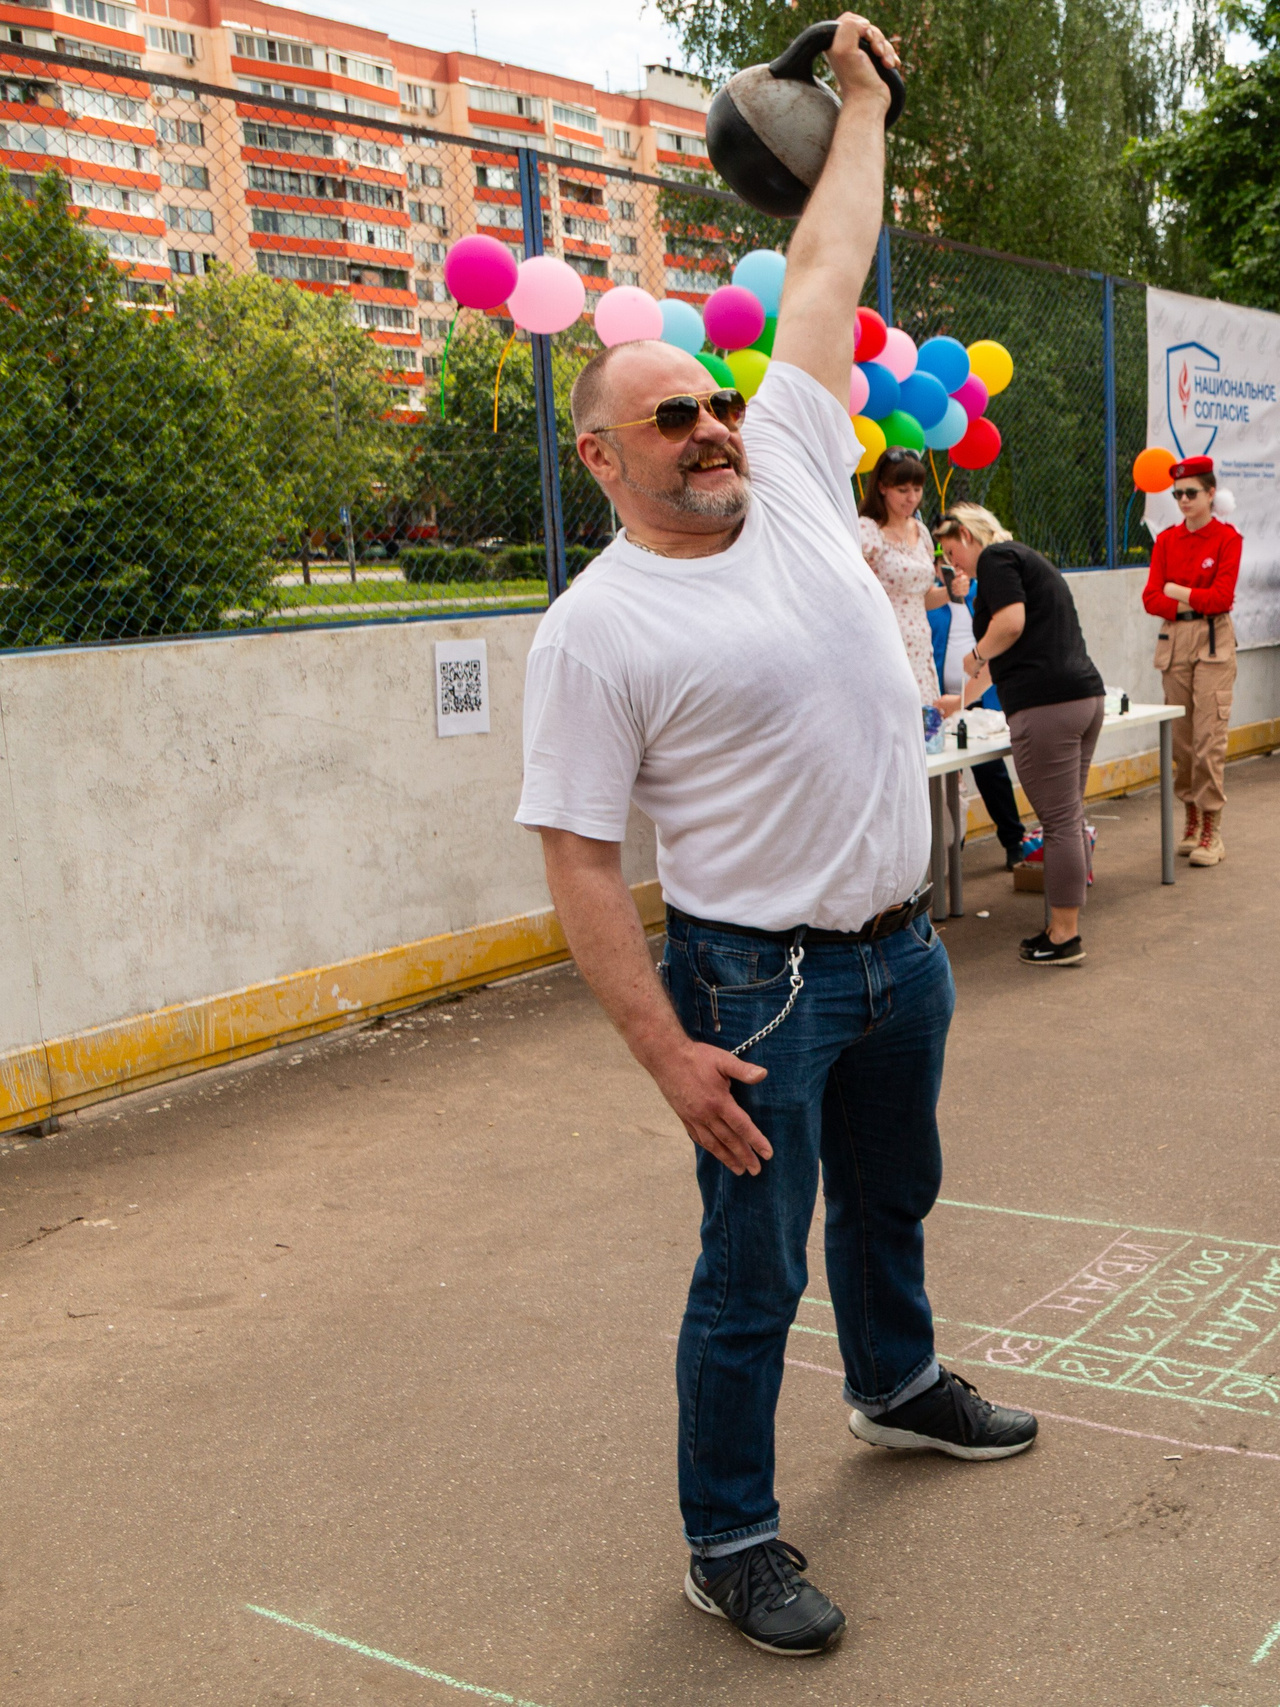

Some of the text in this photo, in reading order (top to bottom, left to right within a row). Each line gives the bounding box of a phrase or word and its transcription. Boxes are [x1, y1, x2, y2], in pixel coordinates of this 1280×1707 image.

[1194, 375, 1277, 402] НАЦИОНАЛЬНОЕ
[1194, 400, 1250, 423] СОГЛАСИЕ
[1038, 1241, 1167, 1313] ИВАН
[1107, 1248, 1243, 1340] ВОЛОДЯ
[984, 1335, 1041, 1364] 30
[1055, 1351, 1121, 1378] 18
[1130, 1359, 1202, 1389] 22
